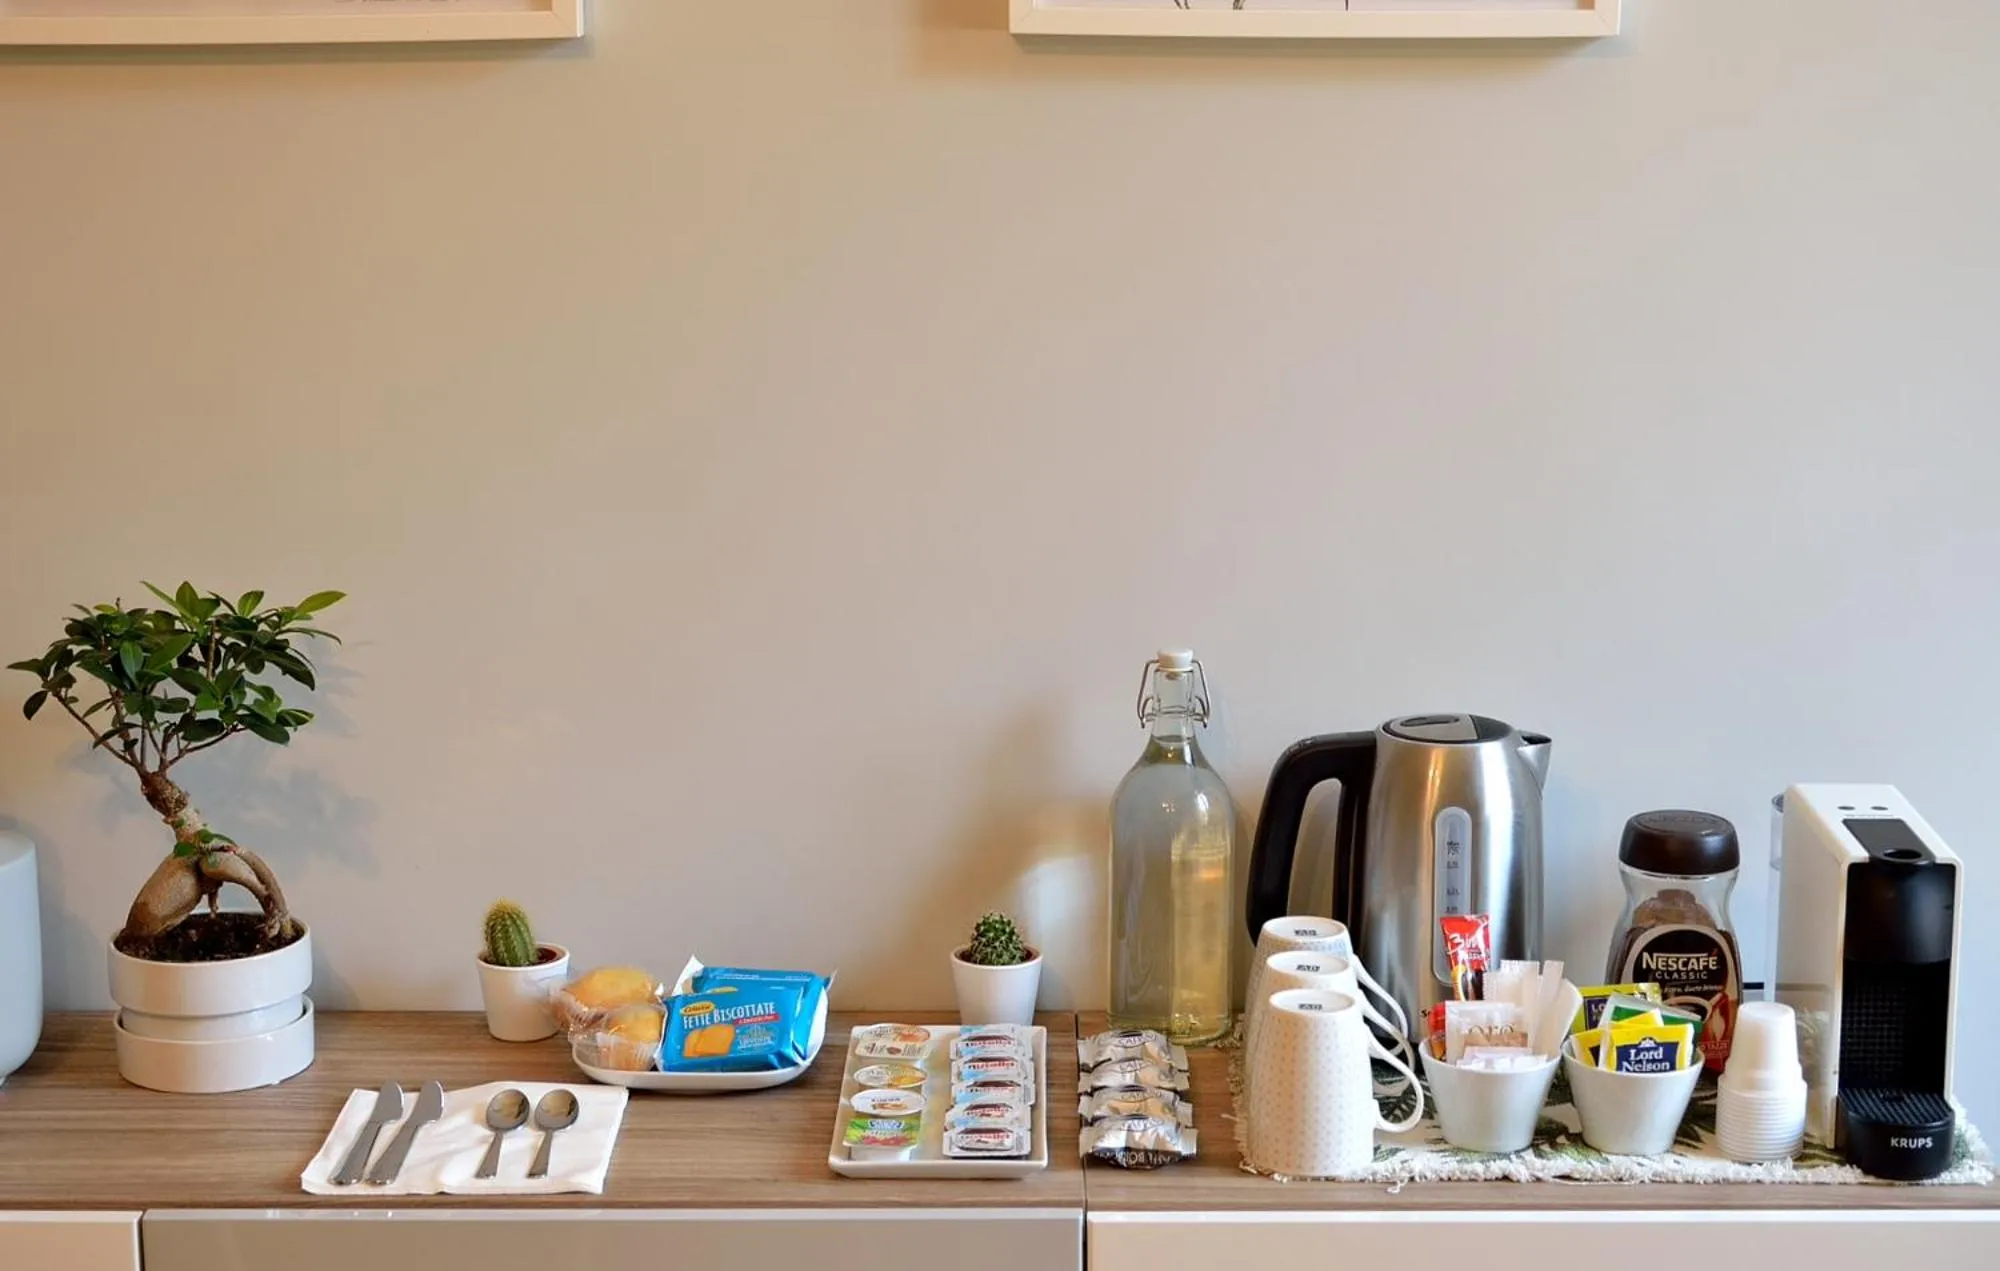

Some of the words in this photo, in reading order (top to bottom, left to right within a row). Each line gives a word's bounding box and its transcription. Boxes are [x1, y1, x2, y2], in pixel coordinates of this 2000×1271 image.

[1642, 948, 1718, 971] NESCAFÉ
[1655, 971, 1708, 980] CLASSIC
[683, 1012, 712, 1030] FETTE
[713, 1002, 776, 1025] BISCOTTATE
[1629, 1046, 1664, 1061] Lord
[1621, 1060, 1670, 1073] Nelson
[1890, 1136, 1933, 1149] KRUPS
